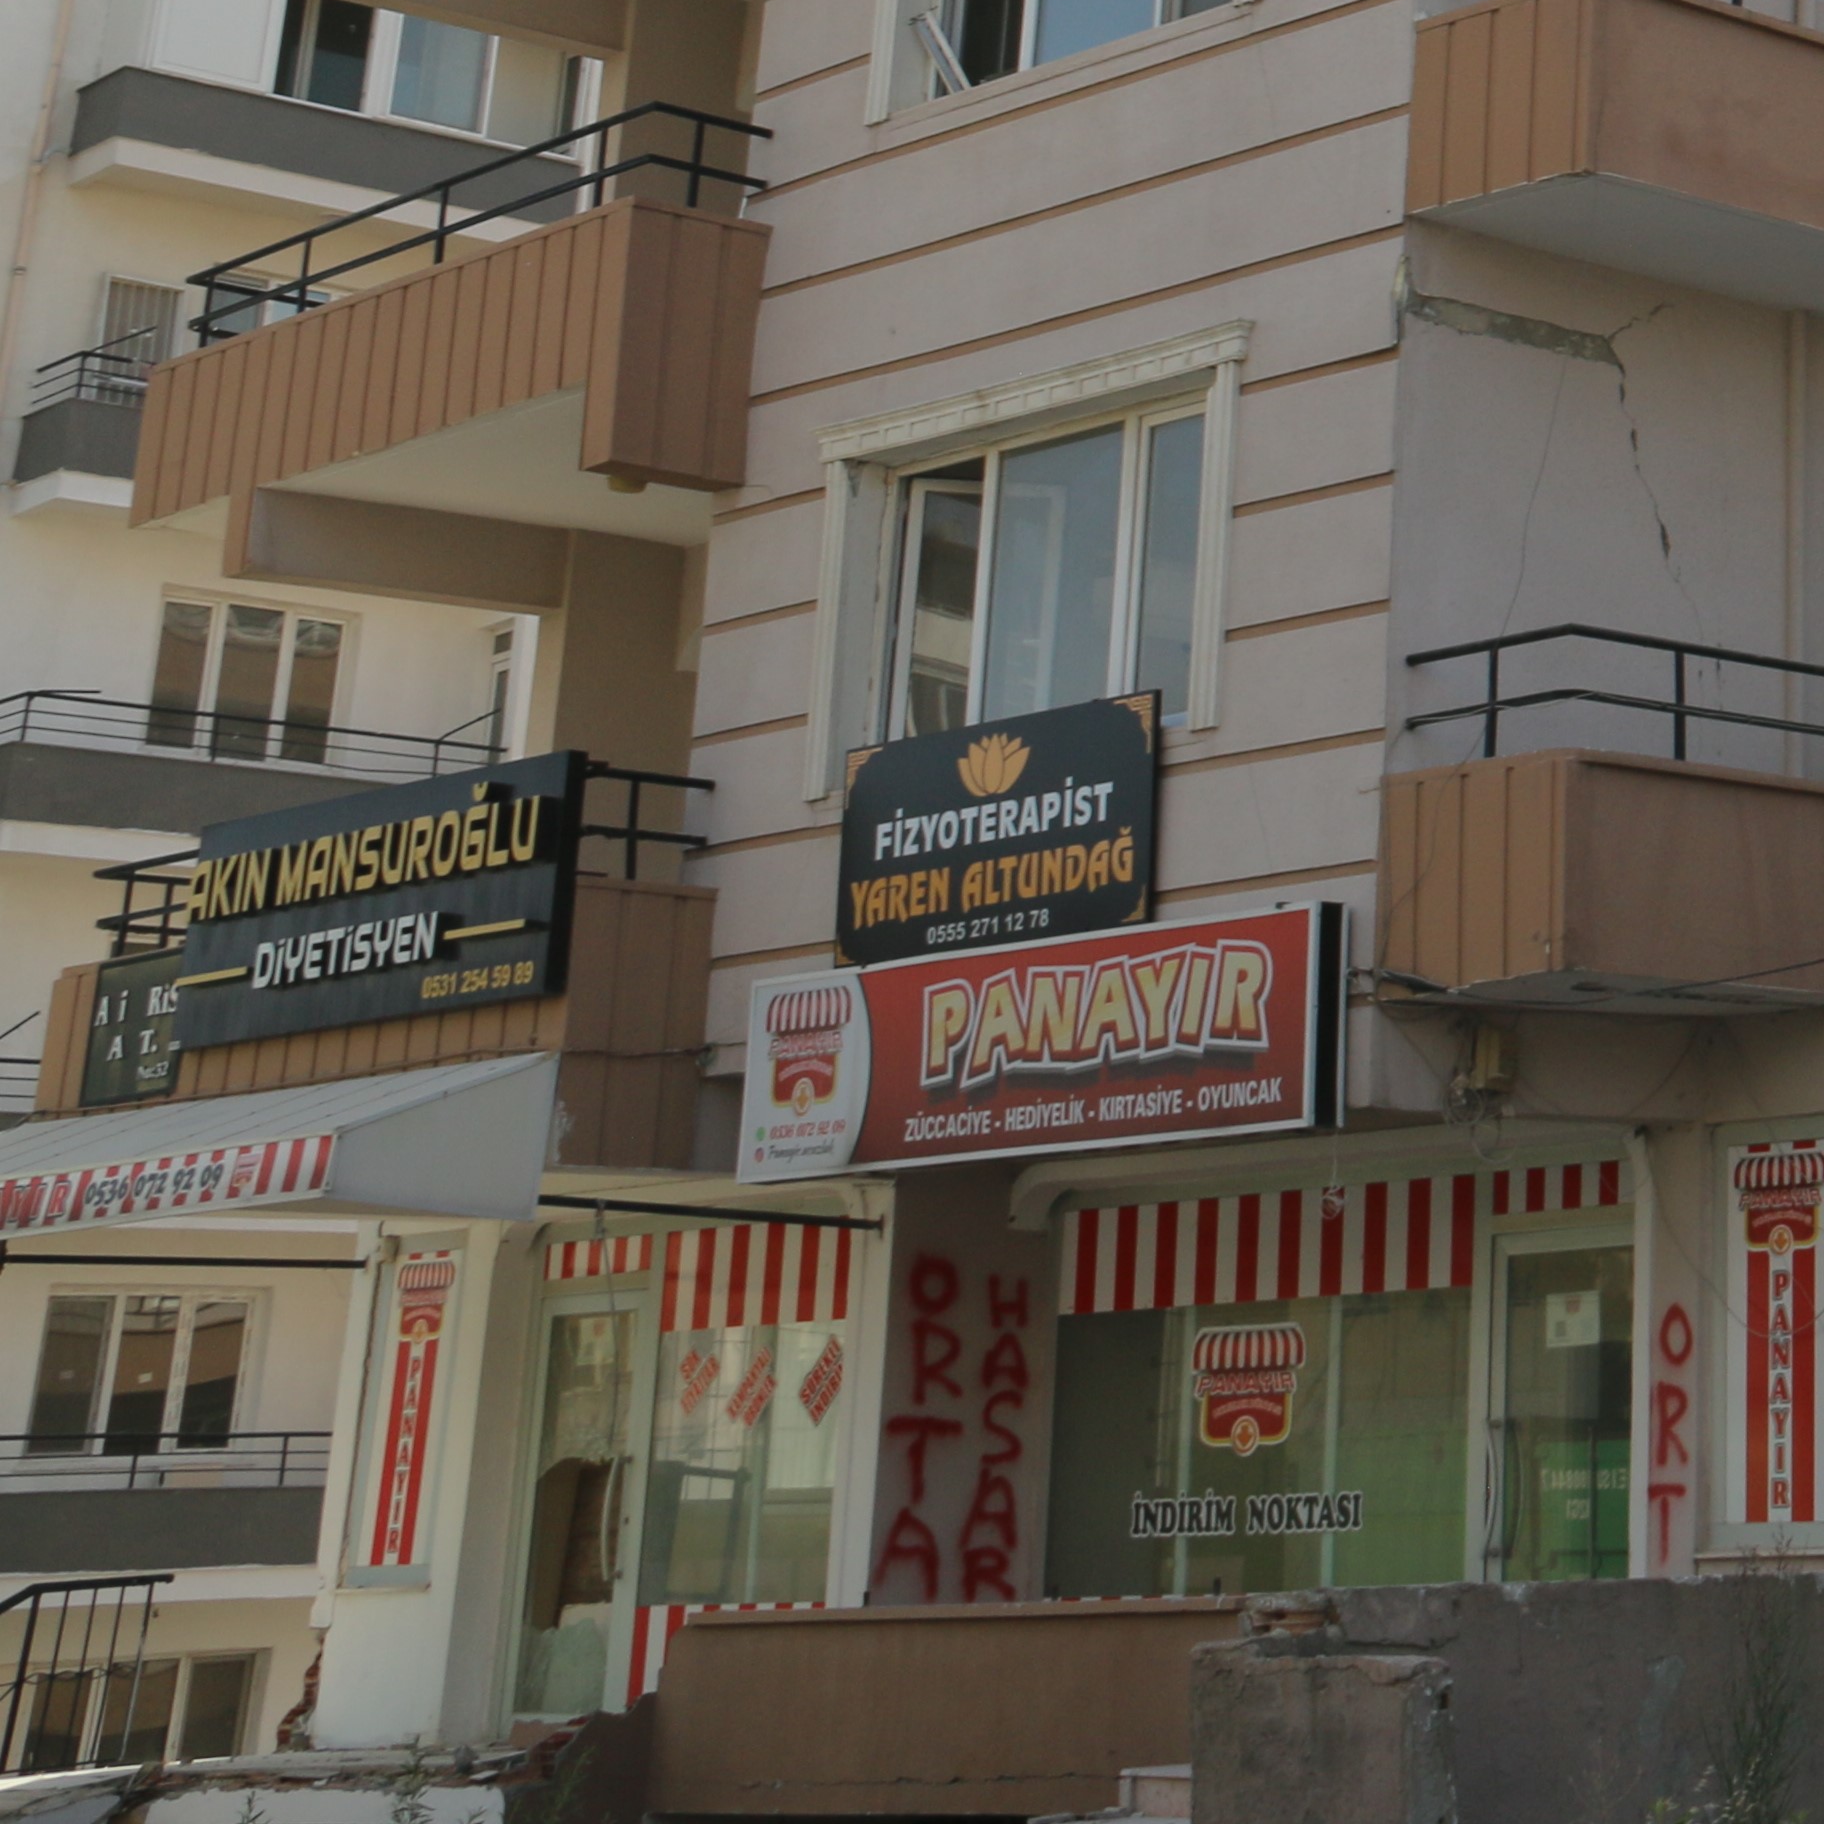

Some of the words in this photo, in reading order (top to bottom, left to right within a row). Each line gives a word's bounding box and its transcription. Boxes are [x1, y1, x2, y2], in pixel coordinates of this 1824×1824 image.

[186, 847, 271, 921] AKIN
[275, 781, 541, 907] MANSUROĞLU
[874, 776, 1114, 861] FİZYOTERAPİST
[851, 866, 950, 930] YAREN
[961, 826, 1134, 913] ALTUNDAĞ
[926, 921, 966, 945] 0555
[970, 916, 999, 939] 271
[1005, 913, 1024, 932] 12
[1029, 908, 1050, 928] 78
[459, 964, 488, 995] 254
[921, 939, 1273, 1090] PANAYIR
[904, 1106, 992, 1142] ZÜCCACİYE
[1005, 1094, 1085, 1131] HEDİYELİK
[1099, 1084, 1183, 1122] KIRTASİYE
[1198, 1077, 1282, 1111] OYUNCAK
[85, 1179, 128, 1208] 0536
[134, 1173, 166, 1199] 072
[172, 1168, 194, 1194] 92
[200, 1164, 223, 1192] 09
[1195, 1372, 1296, 1400] PANAYIR
[1769, 1269, 1792, 1509] PANAYIR
[1131, 1489, 1236, 1538] İNDİRİM
[1247, 1491, 1364, 1534] NOKTASI
